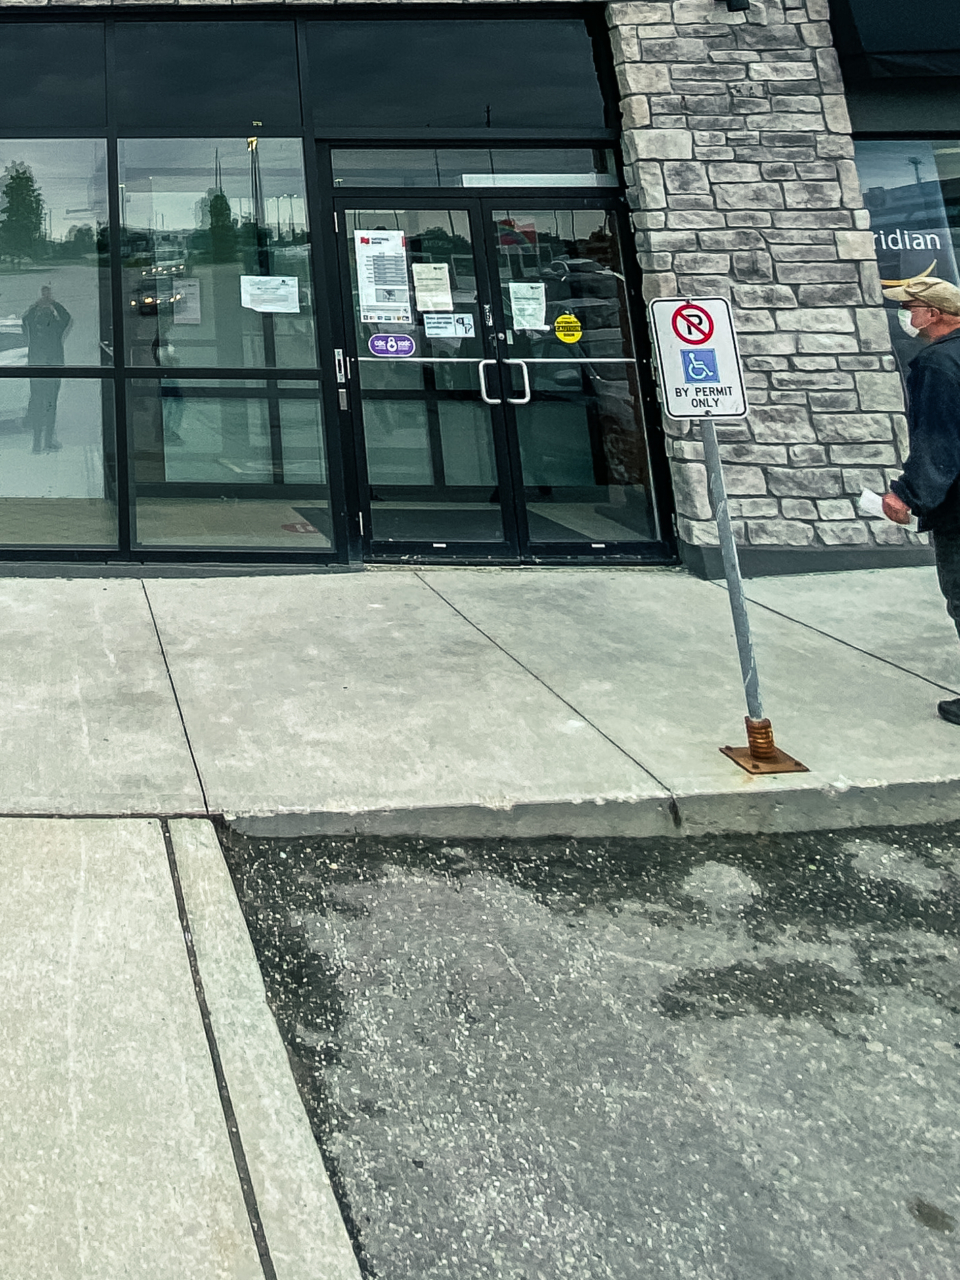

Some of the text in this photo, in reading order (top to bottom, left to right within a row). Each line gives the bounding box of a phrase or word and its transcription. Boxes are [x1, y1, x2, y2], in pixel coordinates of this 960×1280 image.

[674, 386, 733, 398] BY PERMIT
[691, 398, 720, 408] ONLY
